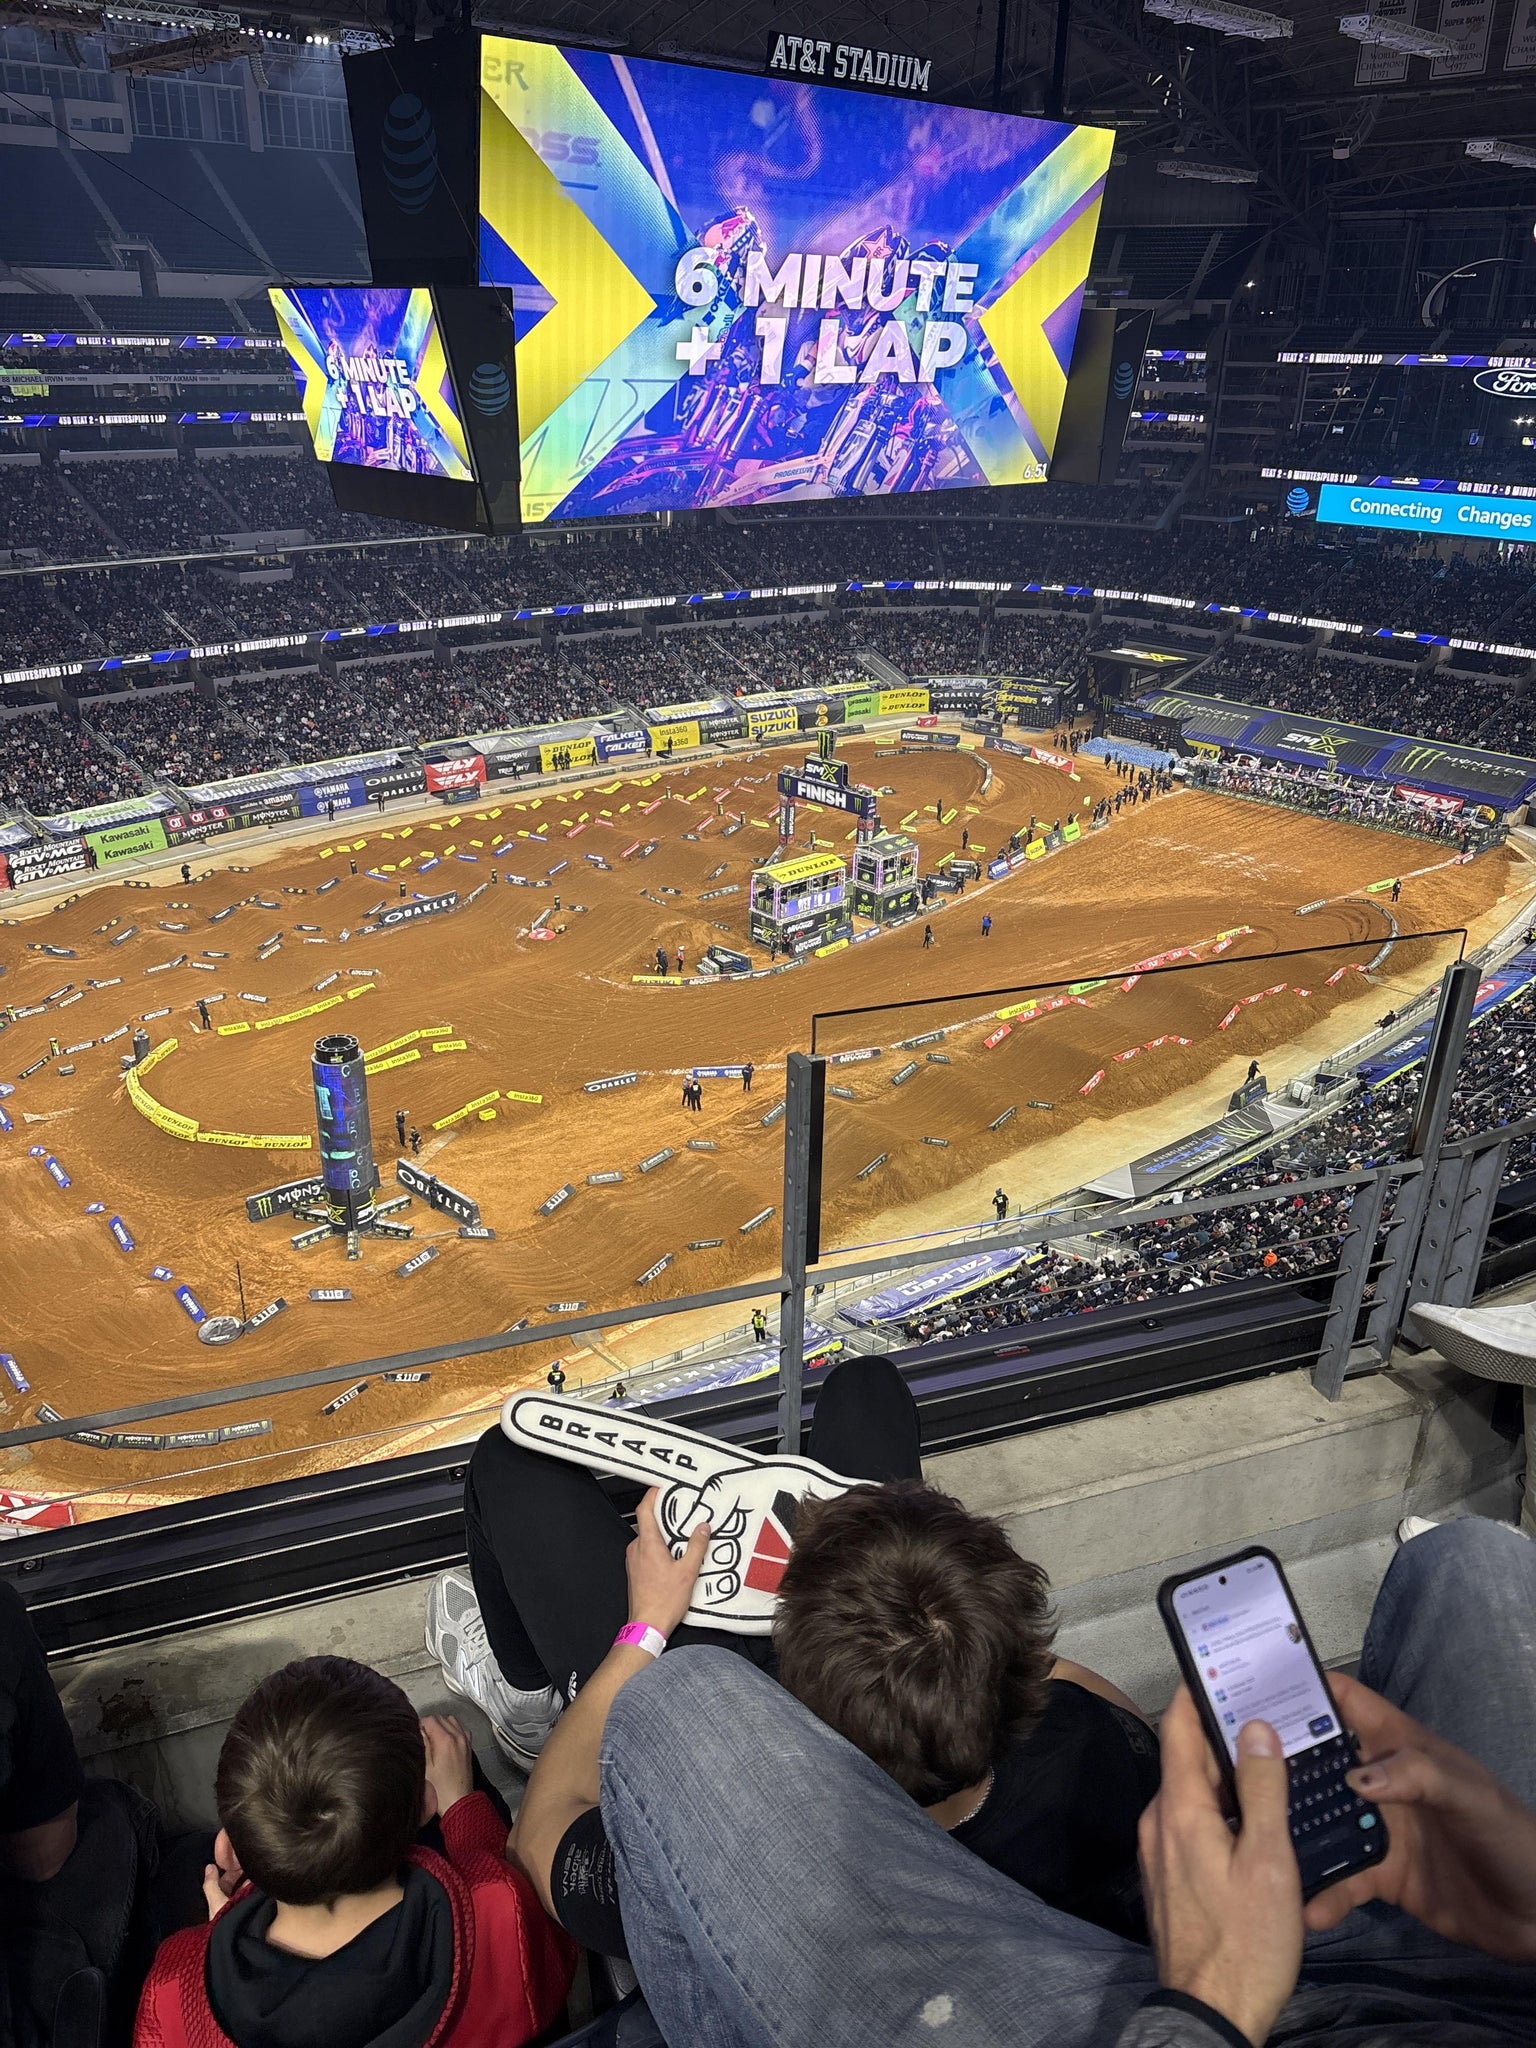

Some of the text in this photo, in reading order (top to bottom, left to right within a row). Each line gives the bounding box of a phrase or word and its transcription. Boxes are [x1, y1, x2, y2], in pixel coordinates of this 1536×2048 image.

[1375, 8, 1406, 16] COWBOYS
[1444, 15, 1485, 26] SUPER BOWL
[770, 34, 931, 91] AT&T STADIUM
[1361, 60, 1404, 71] CHAMPIONS
[1373, 71, 1389, 79] 1971
[675, 247, 979, 313] 6 MINUTE
[676, 317, 968, 385] + 1 LAP
[1282, 352, 1298, 363] HEAT
[1299, 353, 1304, 363] 2
[1315, 353, 1363, 364] MINUTES/PLUS
[1364, 354, 1369, 364] 1
[1370, 354, 1383, 364] LAP
[326, 355, 412, 385] 6 MINUTE
[1488, 357, 1531, 368] 450 HEAT 2
[352, 384, 366, 414] 1
[368, 388, 417, 419] LAP
[72, 416, 88, 424] HEAT
[89, 416, 94, 424] 2
[155, 415, 167, 423] LAP
[1024, 463, 1048, 480] 6:51
[1261, 468, 1277, 478] HEAT
[1277, 469, 1283, 478] 2
[1293, 470, 1339, 483] MINUTES/PLUS
[1339, 474, 1344, 483] 1
[1344, 474, 1358, 484] LAP
[1457, 482, 1472, 492] 450
[1473, 483, 1492, 494] HEAT
[1492, 485, 1499, 495] 2
[1350, 497, 1532, 529] Connecting Changes
[205, 646, 222, 657] HEAT
[223, 645, 229, 654] 2
[295, 634, 308, 646] LAP
[62, 666, 67, 676] 1
[68, 664, 83, 675] LAP
[889, 691, 926, 700] DUNLOP
[888, 702, 925, 711] DUNLOP
[1185, 703, 1251, 721] MONSTER
[750, 709, 796, 723] SUZUKI
[601, 729, 644, 743] FALKEN
[659, 726, 687, 736] Insta360
[751, 721, 796, 736] SUZUKI
[553, 740, 592, 753] DUNLOP
[605, 740, 646, 752] FALKEN
[1282, 732, 1349, 755] SMX
[1442, 754, 1529, 777] MONSTER
[381, 769, 423, 784] OAKLEY
[806, 763, 838, 784] SMX
[322, 782, 350, 793] YAMAHA
[797, 781, 846, 809] FINISH
[263, 793, 293, 805] amazon
[324, 796, 352, 808] YMAHA
[252, 808, 290, 821] MONSTER
[100, 825, 150, 845] Kawasaki
[182, 821, 224, 838] MONSTER
[20, 838, 80, 857] ROCKY MOUNTAIN
[104, 841, 154, 860] Kawasaki
[24, 854, 85, 874] ROCKY MOUNTAIN
[788, 857, 837, 876] DUNLOP
[405, 896, 456, 918] OAKLEY
[990, 1029, 1006, 1043] FLY
[601, 1074, 638, 1090] OAKLEY
[161, 1114, 194, 1132] DUNLOP
[208, 1138, 248, 1146] DUNLOP
[539, 1413, 699, 1472] BRAAAP
